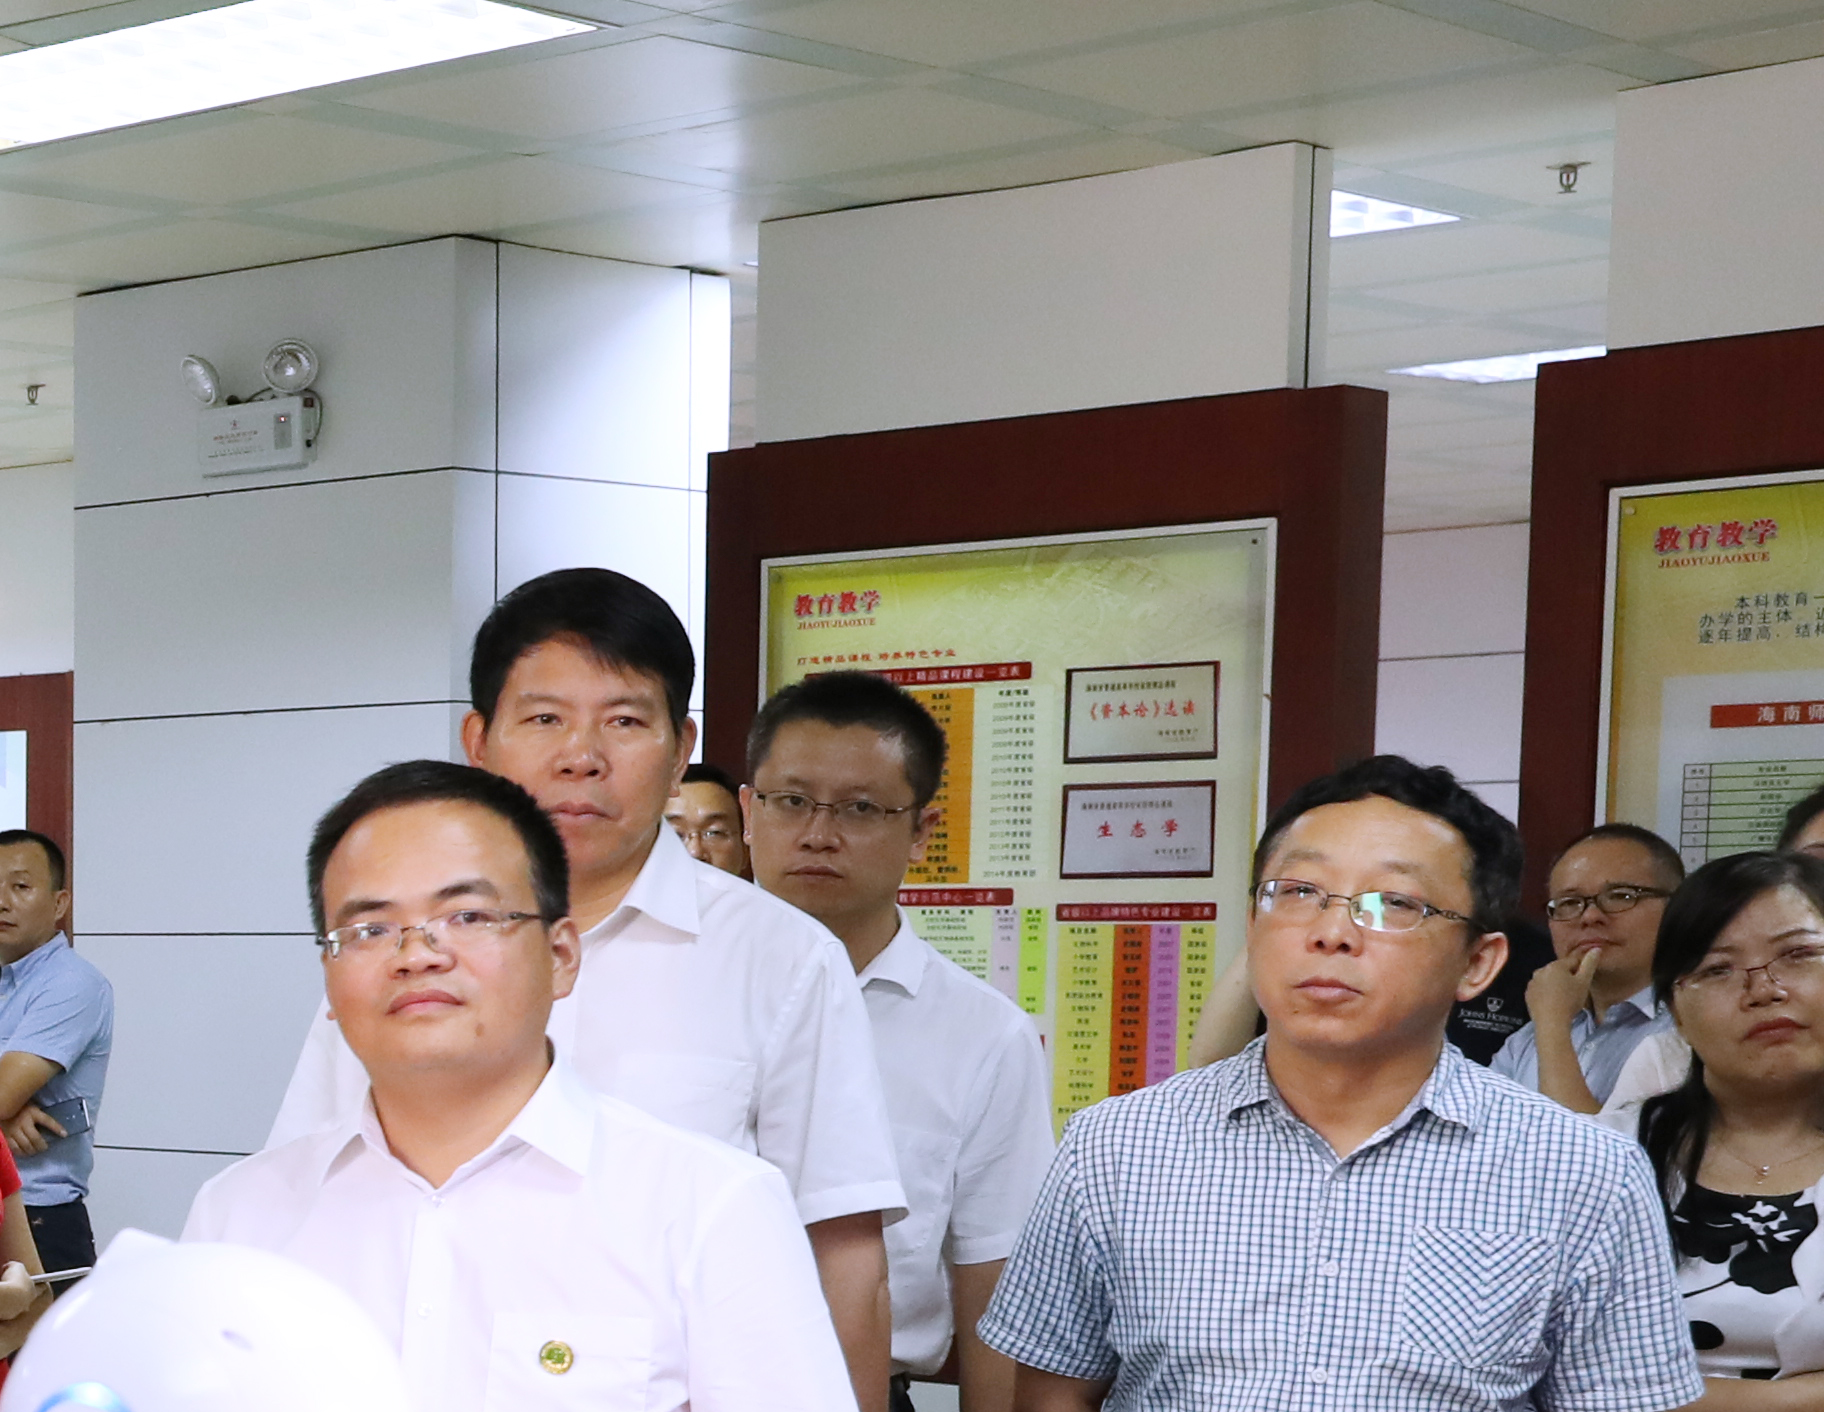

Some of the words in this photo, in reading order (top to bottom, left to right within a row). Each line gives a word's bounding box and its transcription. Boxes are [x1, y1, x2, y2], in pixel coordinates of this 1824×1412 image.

[1654, 518, 1778, 554] 教育教学
[1658, 551, 1770, 569] JIAOYUJIAOXUE
[794, 590, 881, 617] 教育教学
[797, 617, 876, 631] JIAOYUJIAOXUE
[1097, 818, 1178, 838] 生态学
